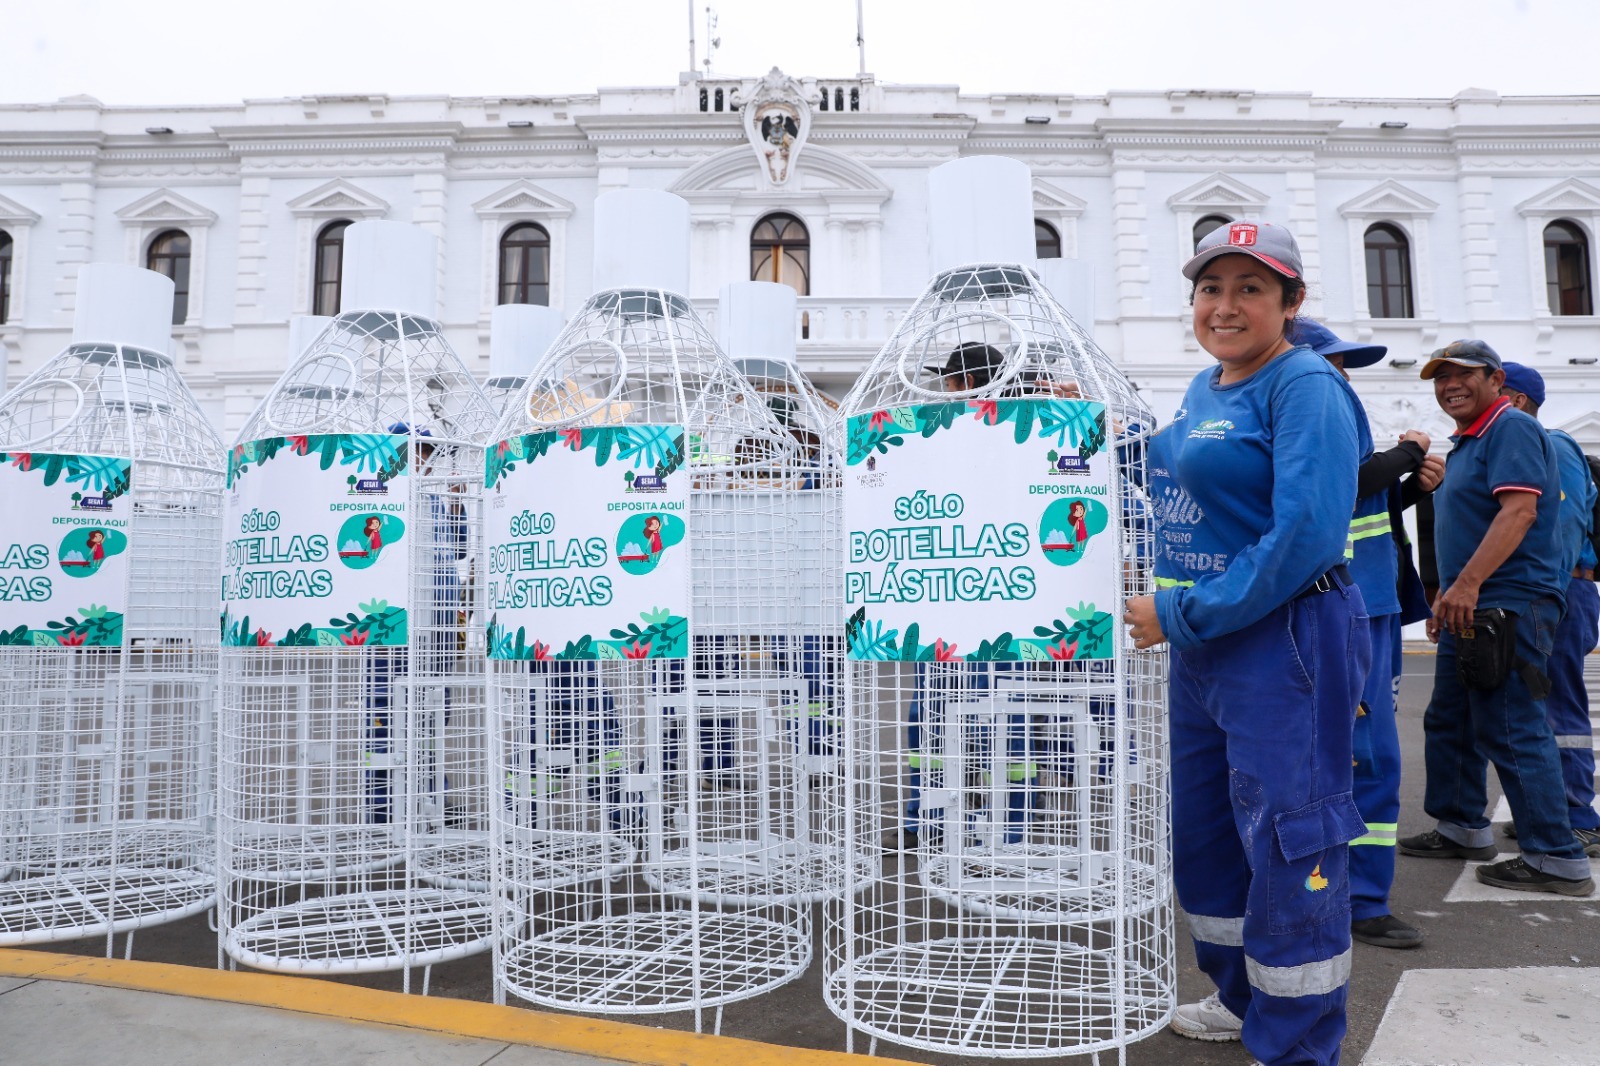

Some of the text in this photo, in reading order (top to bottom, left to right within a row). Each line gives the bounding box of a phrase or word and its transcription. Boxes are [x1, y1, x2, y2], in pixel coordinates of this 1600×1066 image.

[1028, 483, 1107, 496] DEPOSITA AQUÍ
[329, 502, 405, 512] DEPOSITA AQUÍ
[607, 499, 685, 511] DEPOSITA AQUÍ
[894, 490, 964, 521] SÓLO
[52, 517, 102, 526] DEPOSITA
[241, 508, 280, 533] SÓLO
[510, 510, 555, 537] SÓLO
[225, 534, 329, 568] BOTELLAS
[489, 537, 608, 574] BOTELLAS
[850, 523, 1030, 563] BOTELLAS
[1165, 544, 1228, 572] VERDE
[221, 566, 333, 601] PLÁSTICAS
[488, 573, 613, 609] PLÁSTICAS
[846, 562, 1036, 603] PLÁSTICAS
